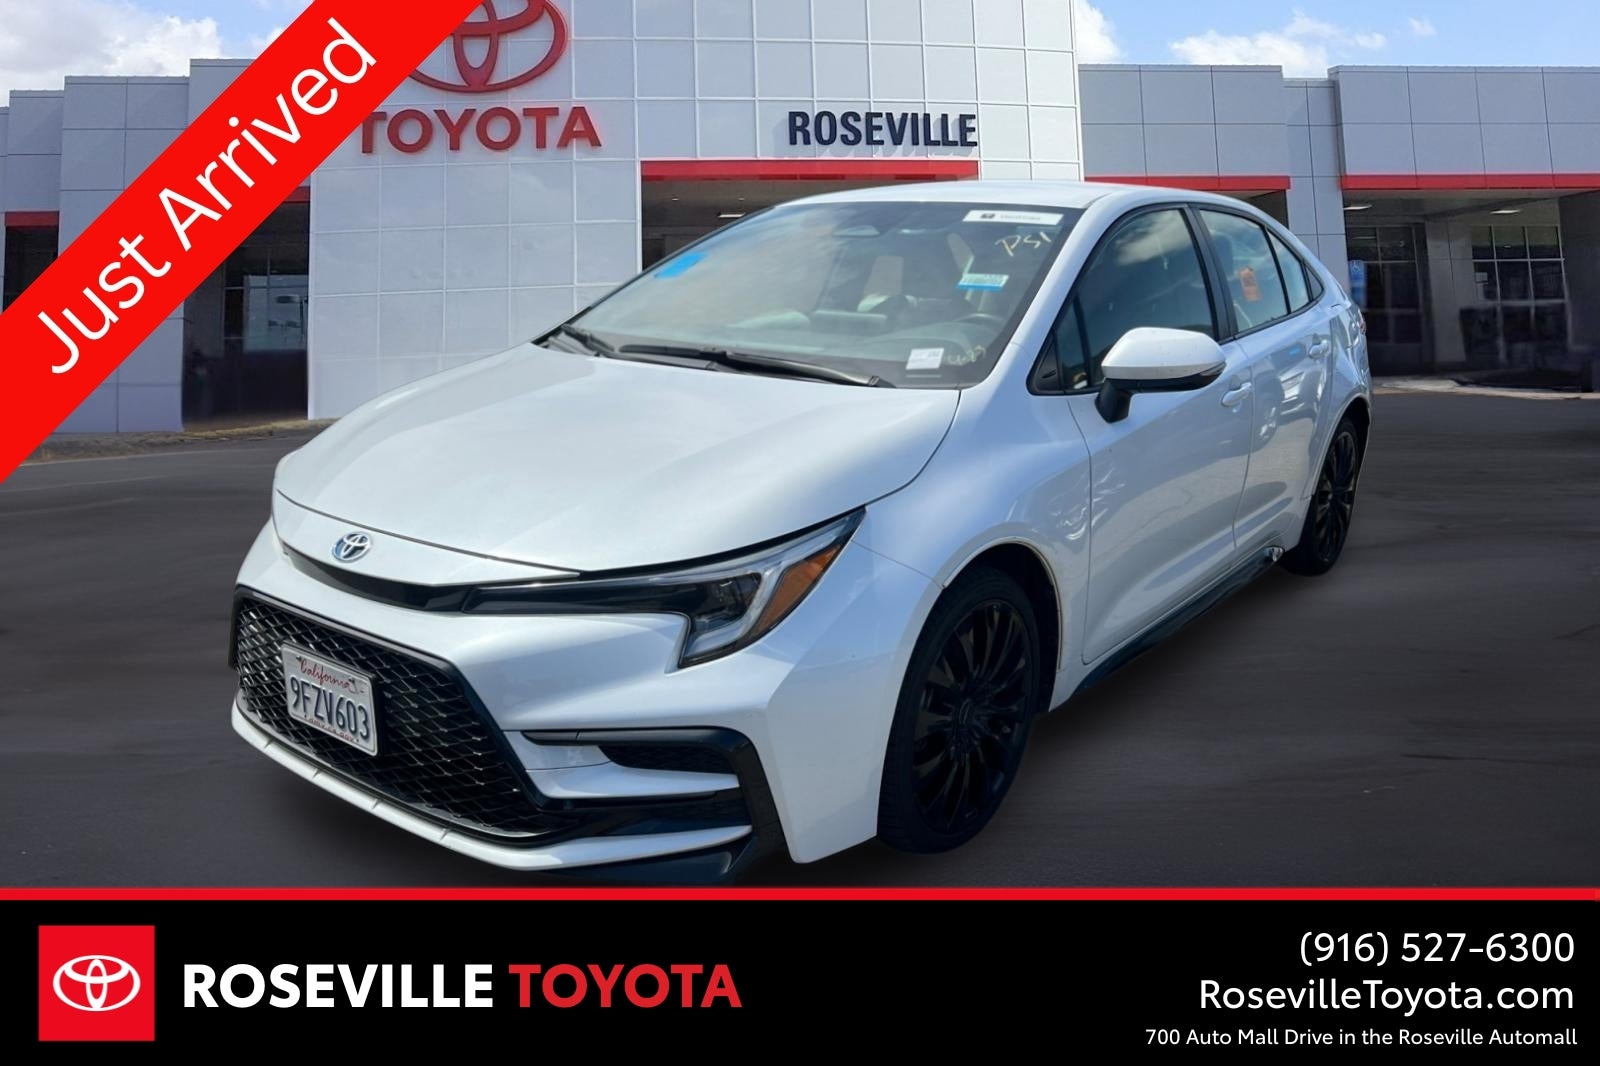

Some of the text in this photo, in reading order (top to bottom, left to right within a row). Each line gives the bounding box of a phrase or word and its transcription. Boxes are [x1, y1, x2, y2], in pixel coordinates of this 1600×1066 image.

[361, 106, 602, 154] TOYOTA
[788, 110, 978, 147] ROSEVILLE
[300, 659, 350, 689] California
[290, 676, 370, 740] 9FZV603
